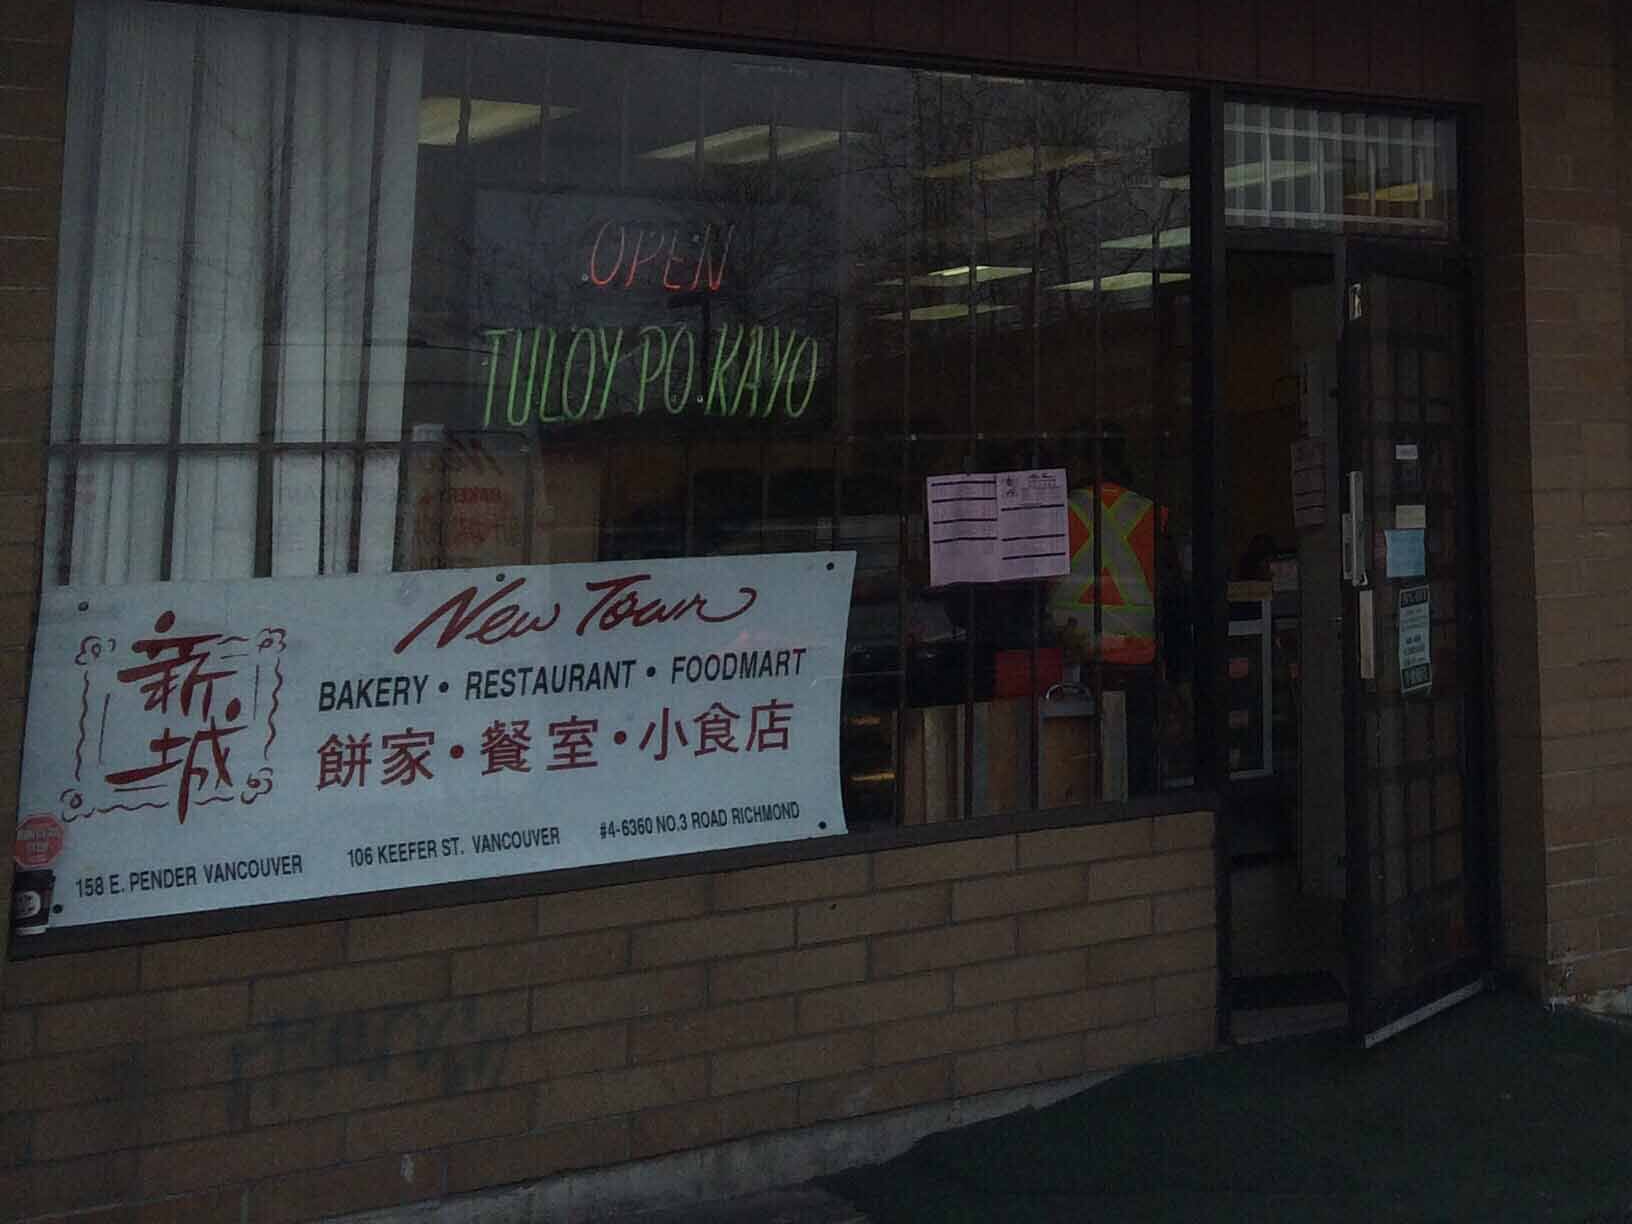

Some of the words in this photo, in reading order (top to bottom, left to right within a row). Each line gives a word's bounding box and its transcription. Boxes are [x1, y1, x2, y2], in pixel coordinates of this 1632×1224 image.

[590, 221, 735, 290] OPEN
[483, 325, 627, 433] TULOY
[636, 323, 696, 416] PO
[704, 321, 819, 417] KAYO
[394, 577, 560, 655] New
[575, 574, 758, 637] Town
[317, 675, 429, 712] BAKERY
[465, 659, 637, 700] RESTAURANT
[671, 648, 807, 685] FOODMART
[691, 809, 728, 829] ROAD
[731, 801, 800, 825] RICHMOND
[75, 877, 104, 898] 158
[109, 874, 125, 895] E.
[129, 865, 197, 892] PENDER
[202, 854, 303, 885] VANCOUVER
[347, 848, 373, 868] 106
[377, 839, 438, 864] KEEFER
[441, 837, 464, 857] ST.
[472, 827, 561, 855] VANCOUVER
